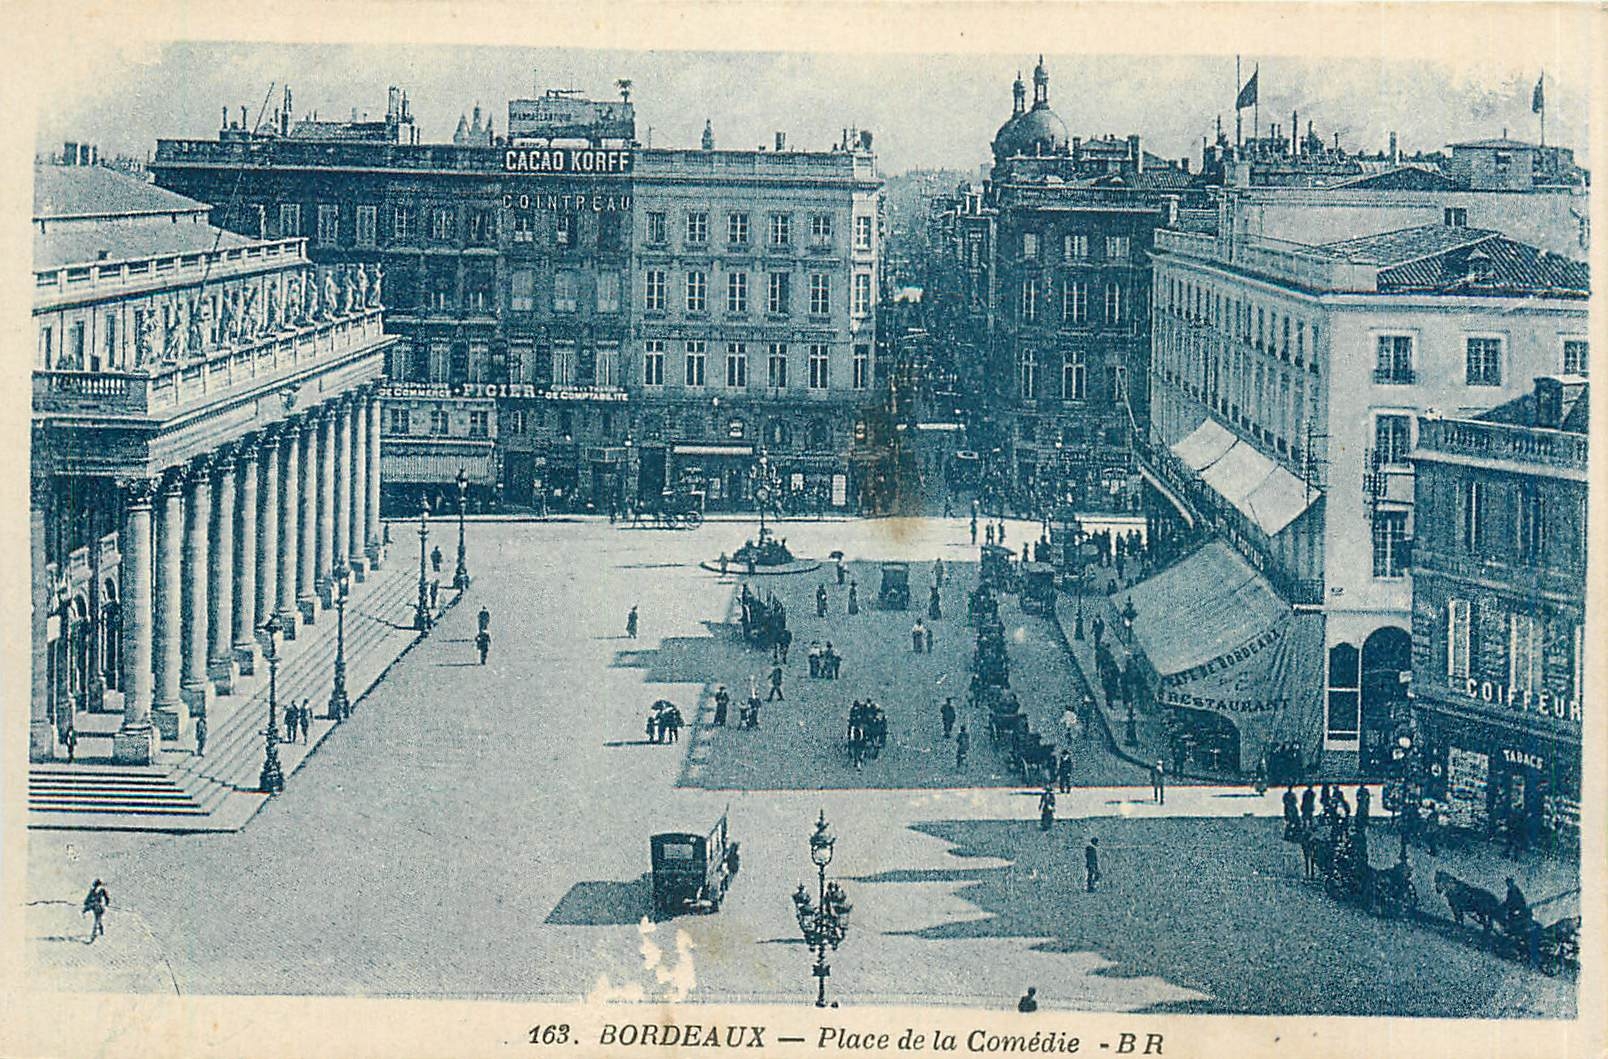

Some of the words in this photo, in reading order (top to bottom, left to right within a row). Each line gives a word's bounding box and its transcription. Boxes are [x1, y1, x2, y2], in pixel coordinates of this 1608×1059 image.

[506, 151, 564, 171] CACAO
[571, 151, 630, 172] KORFF
[502, 194, 631, 211] COINTREAU
[394, 388, 452, 398] COMMERCE
[462, 383, 536, 398] PIGIER
[1168, 691, 1290, 713] RESTAURANT
[1466, 678, 1582, 721] COIFFEUR
